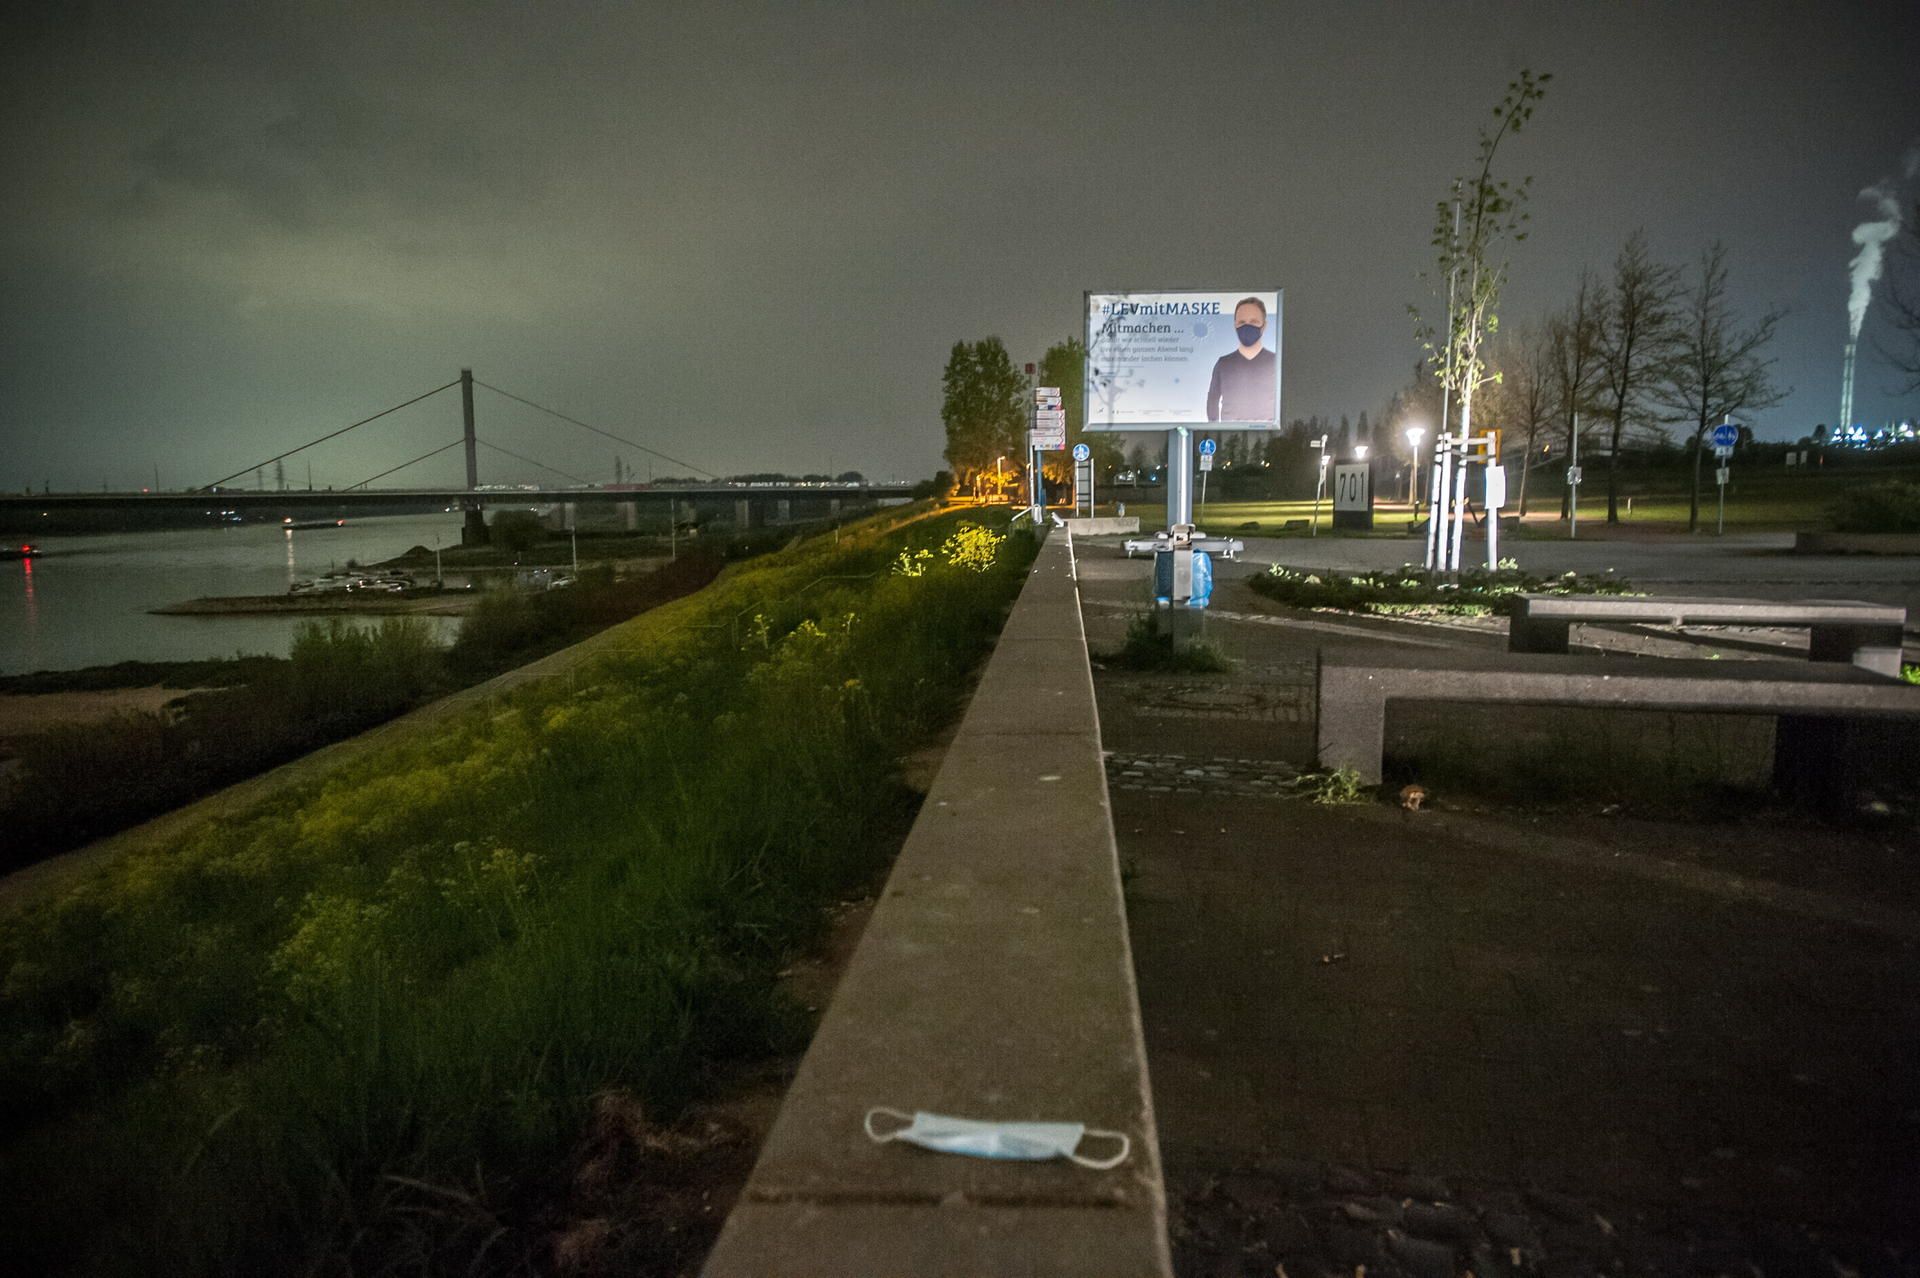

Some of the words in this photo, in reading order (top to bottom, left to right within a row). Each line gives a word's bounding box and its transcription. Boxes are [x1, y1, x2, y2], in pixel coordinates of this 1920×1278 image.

[1102, 302, 1220, 315] #LEVmitMASKE
[1102, 322, 1171, 333] Mitmachen
[1340, 472, 1364, 502] 701
